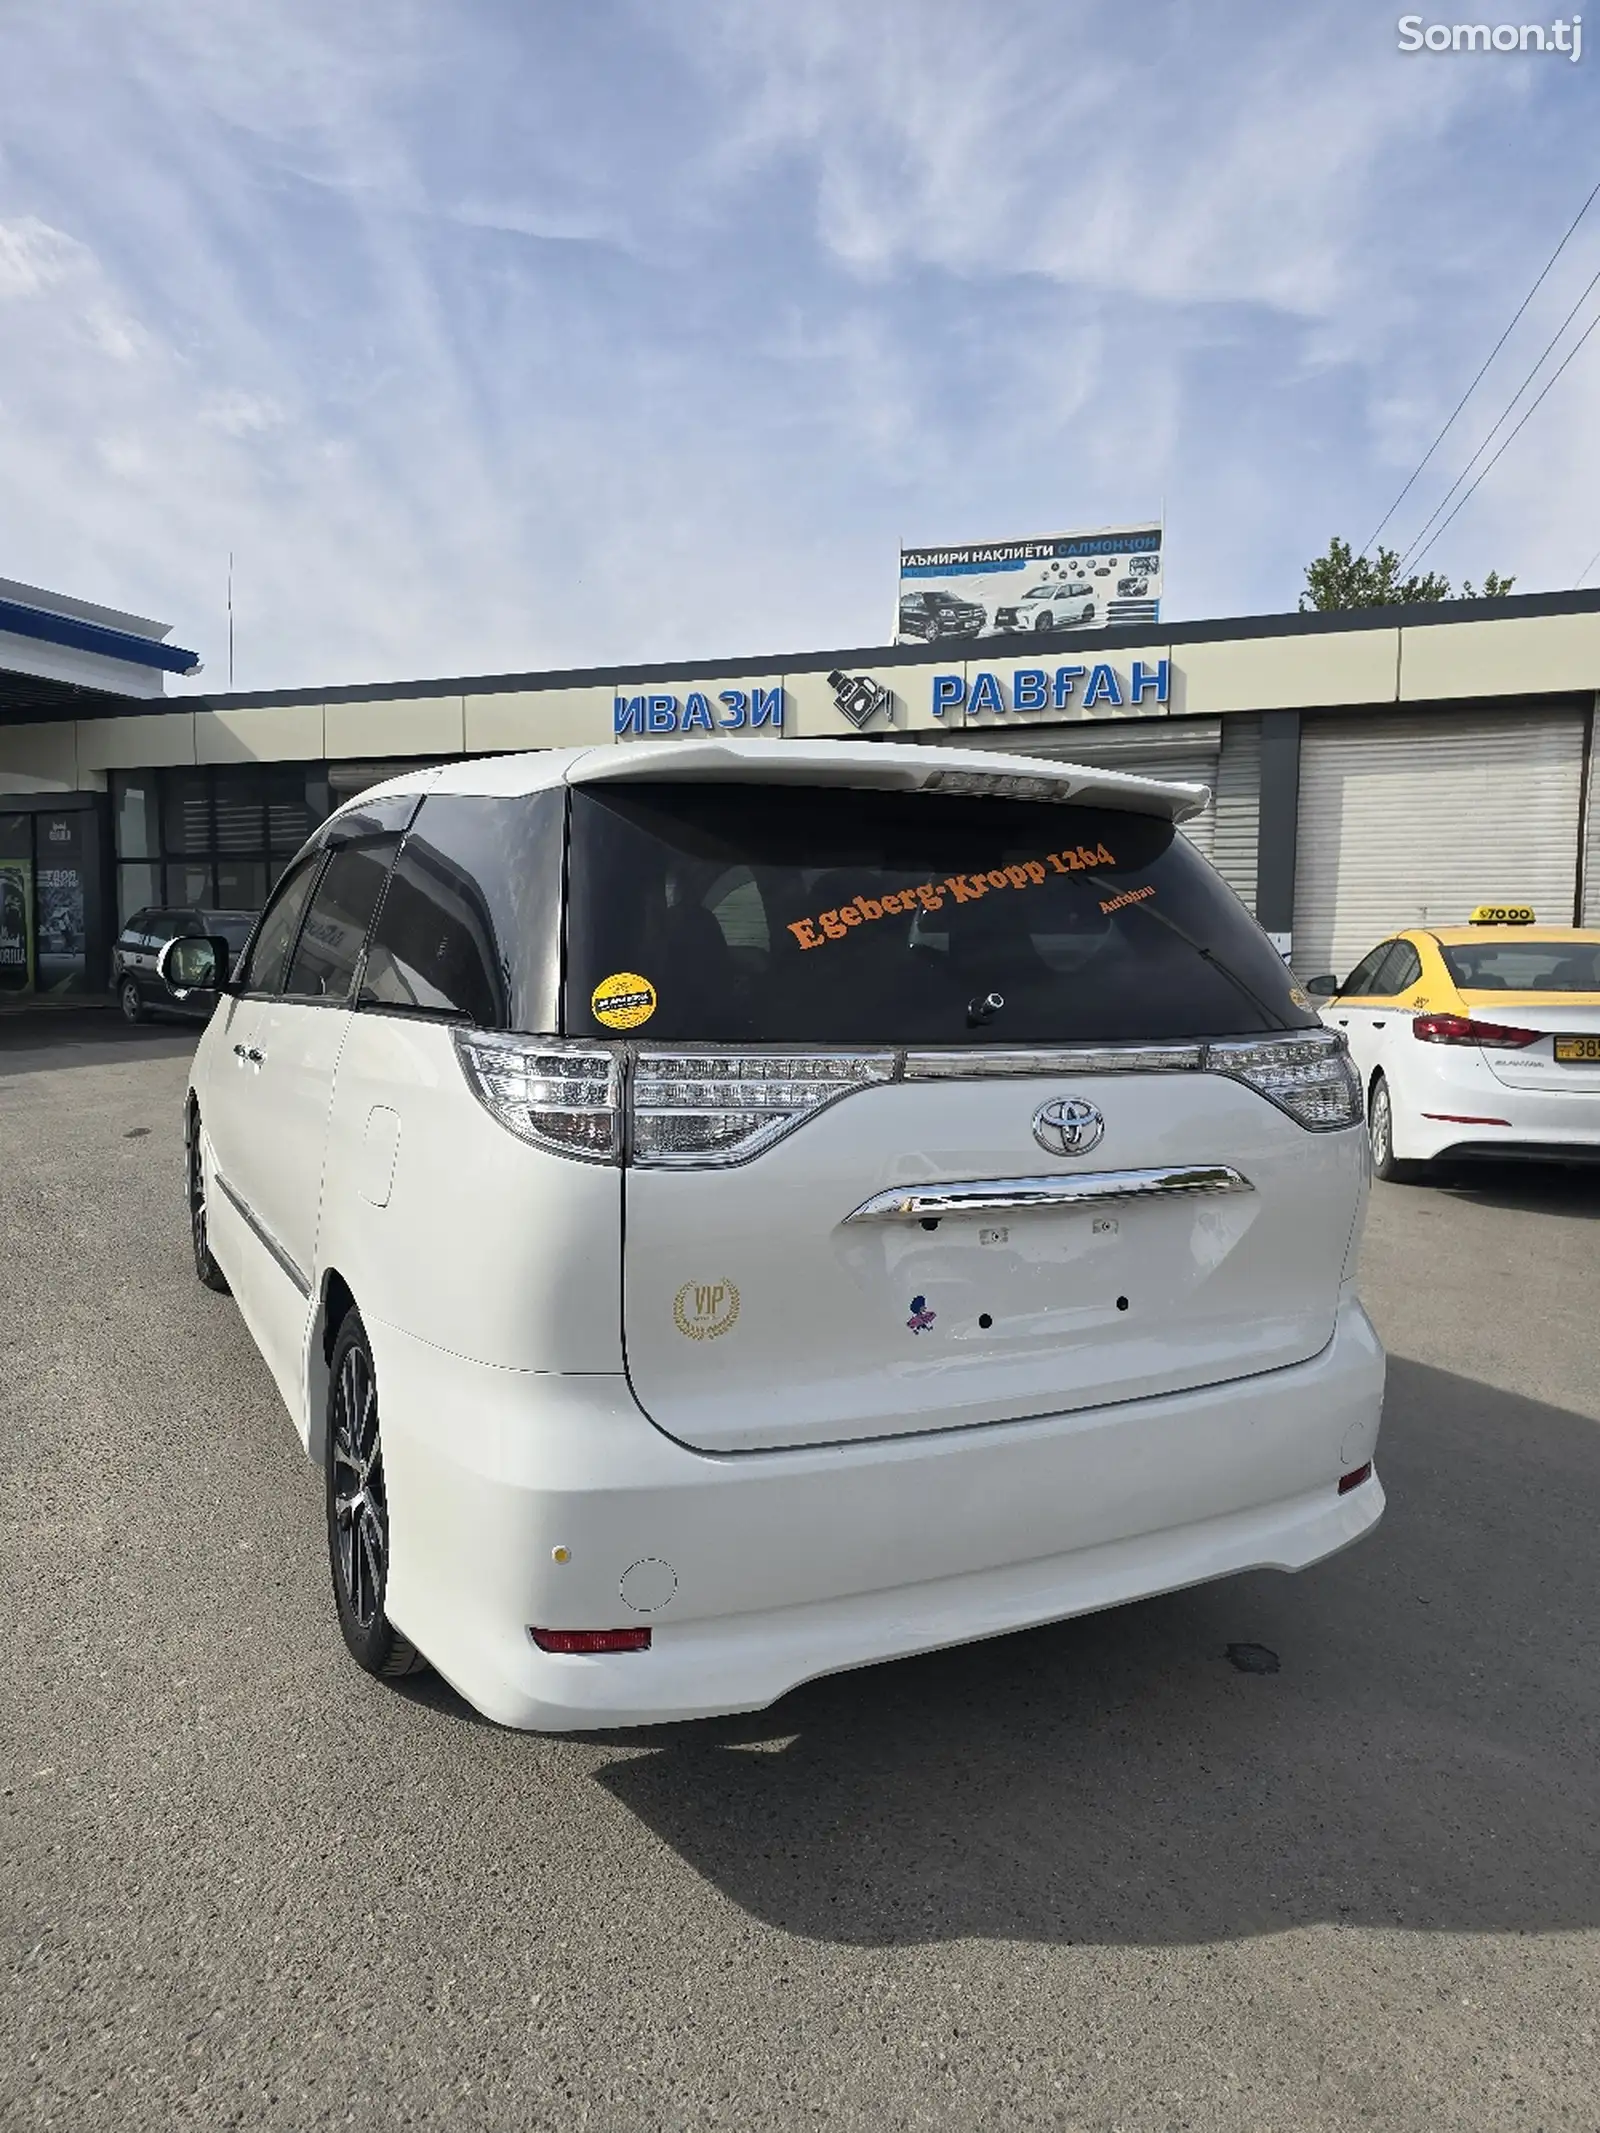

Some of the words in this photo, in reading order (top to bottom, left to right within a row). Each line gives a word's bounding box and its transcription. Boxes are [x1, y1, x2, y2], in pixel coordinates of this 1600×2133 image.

[613, 686, 784, 736] ИВАЗИ
[932, 659, 1169, 718] РАВҒАН
[695, 1286, 724, 1314] VIP
